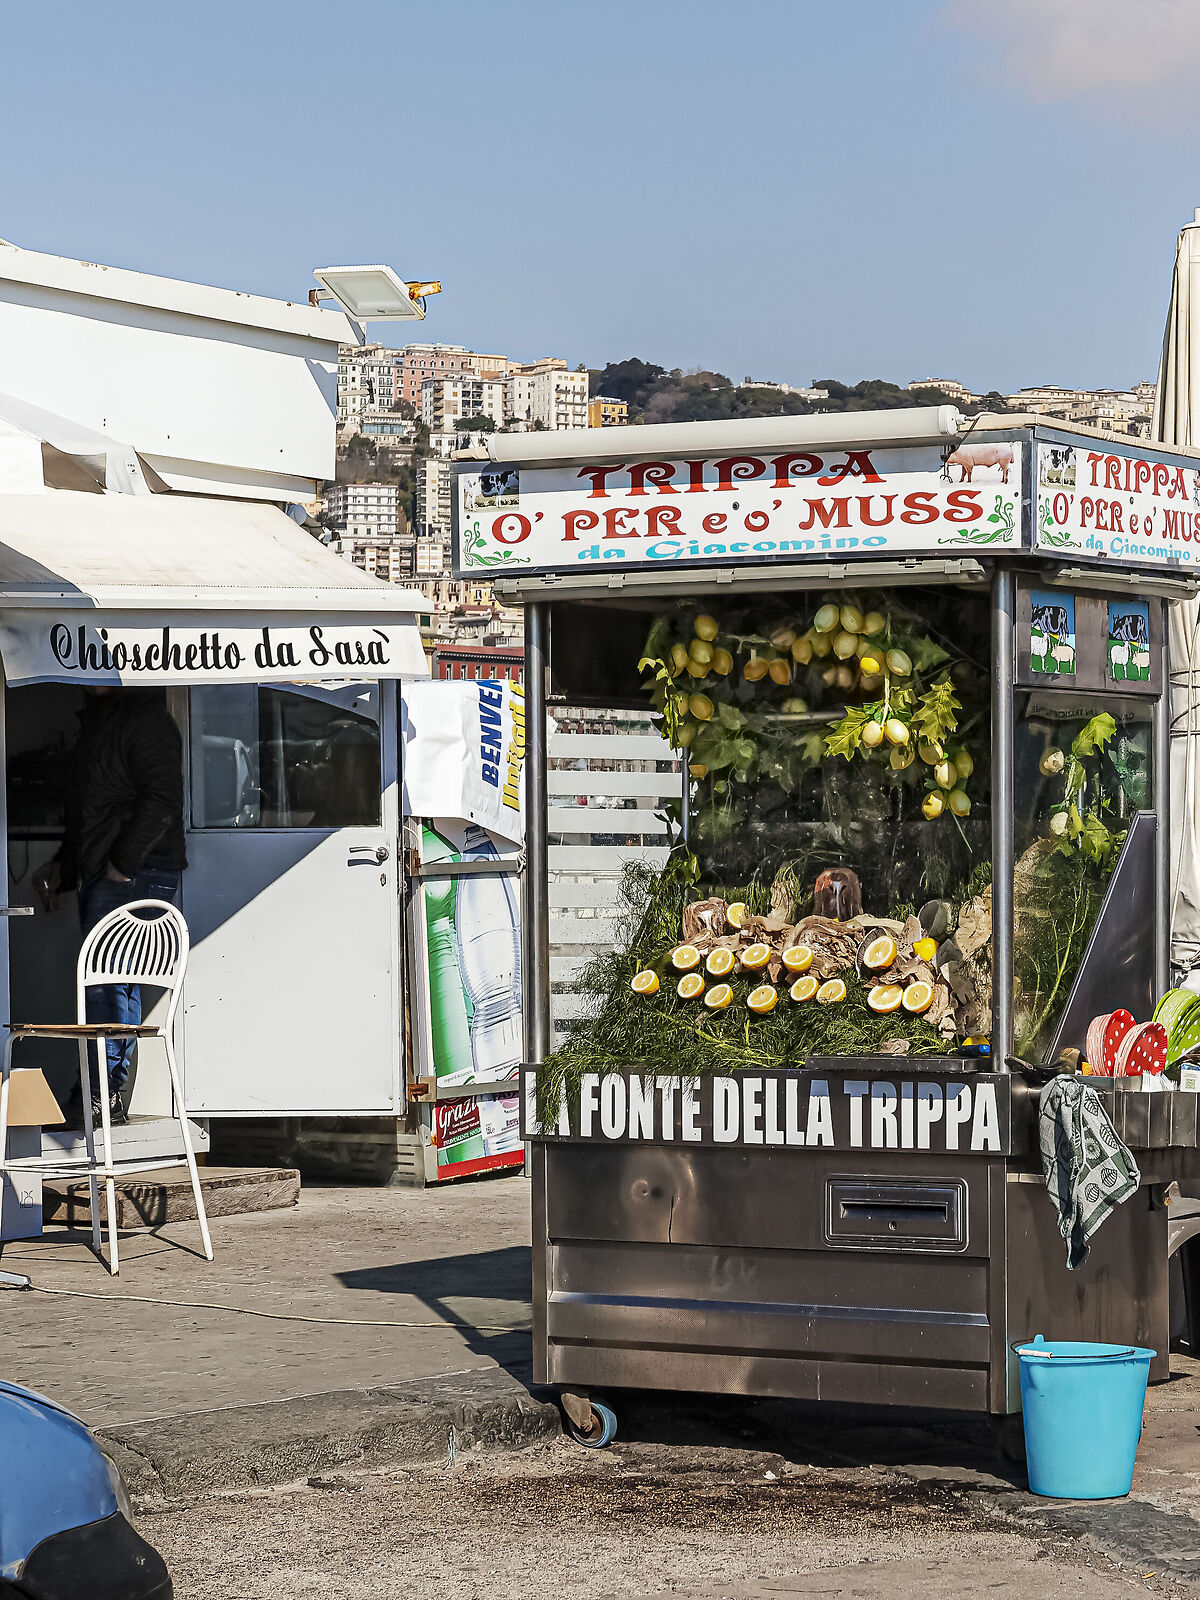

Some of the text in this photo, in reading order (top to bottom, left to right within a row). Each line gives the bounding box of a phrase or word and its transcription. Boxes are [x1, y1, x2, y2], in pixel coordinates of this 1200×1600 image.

[577, 450, 888, 498] TRIPPA
[1086, 452, 1190, 501] TRIPPA
[491, 511, 544, 544] O'
[561, 505, 687, 542] PER
[798, 490, 984, 531] MUSS
[1052, 492, 1075, 526] O'
[1079, 496, 1125, 534] PER
[577, 533, 888, 560] da Giacomino
[1085, 533, 1191, 561] da Giacomino
[50, 623, 391, 671] Chioschetto da Sasà
[525, 1071, 1002, 1152] LA FONTE DELLA TRIPPA
